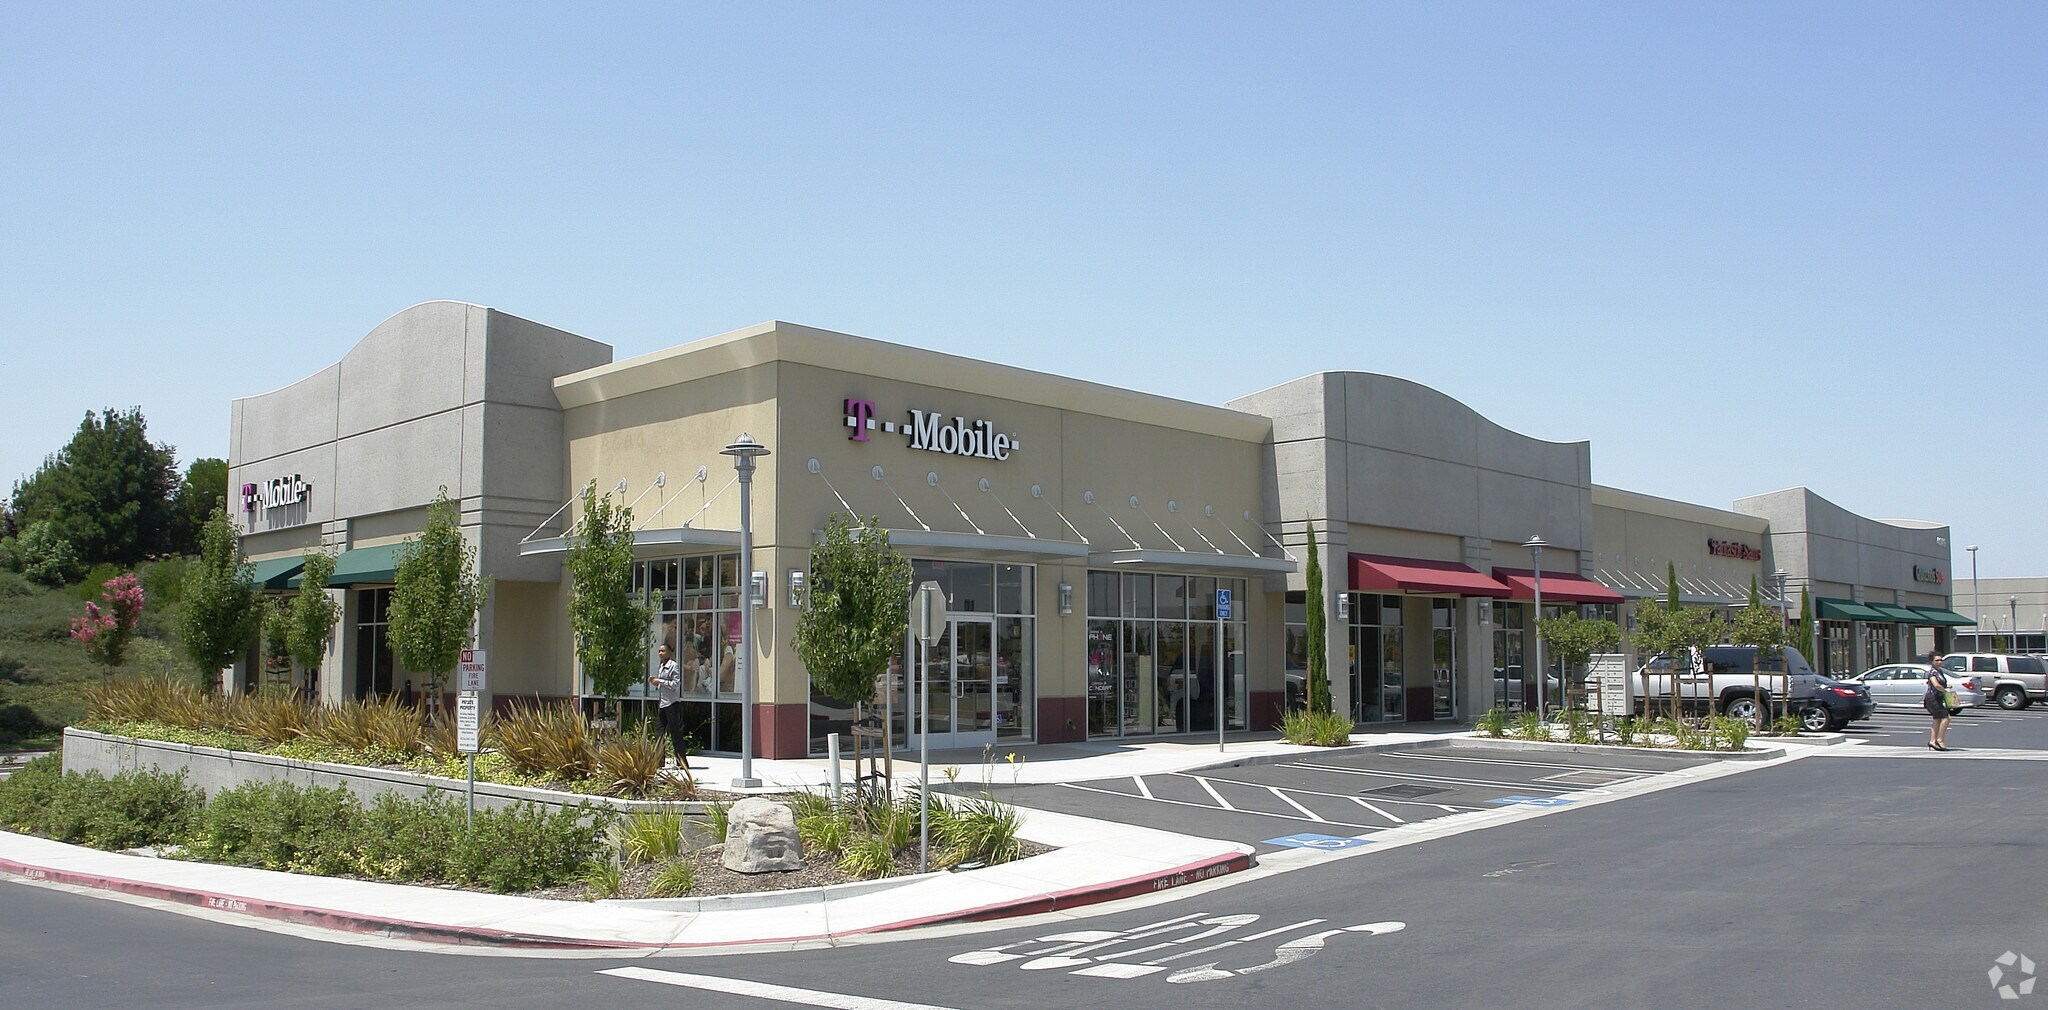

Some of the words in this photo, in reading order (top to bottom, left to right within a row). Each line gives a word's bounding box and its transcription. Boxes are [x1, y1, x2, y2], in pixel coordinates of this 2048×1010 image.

[462, 651, 472, 661] NO
[463, 664, 485, 672] PARKING
[1153, 877, 1169, 890] FIRE
[1195, 868, 1205, 880] NO
[1206, 862, 1230, 878] PARKING
